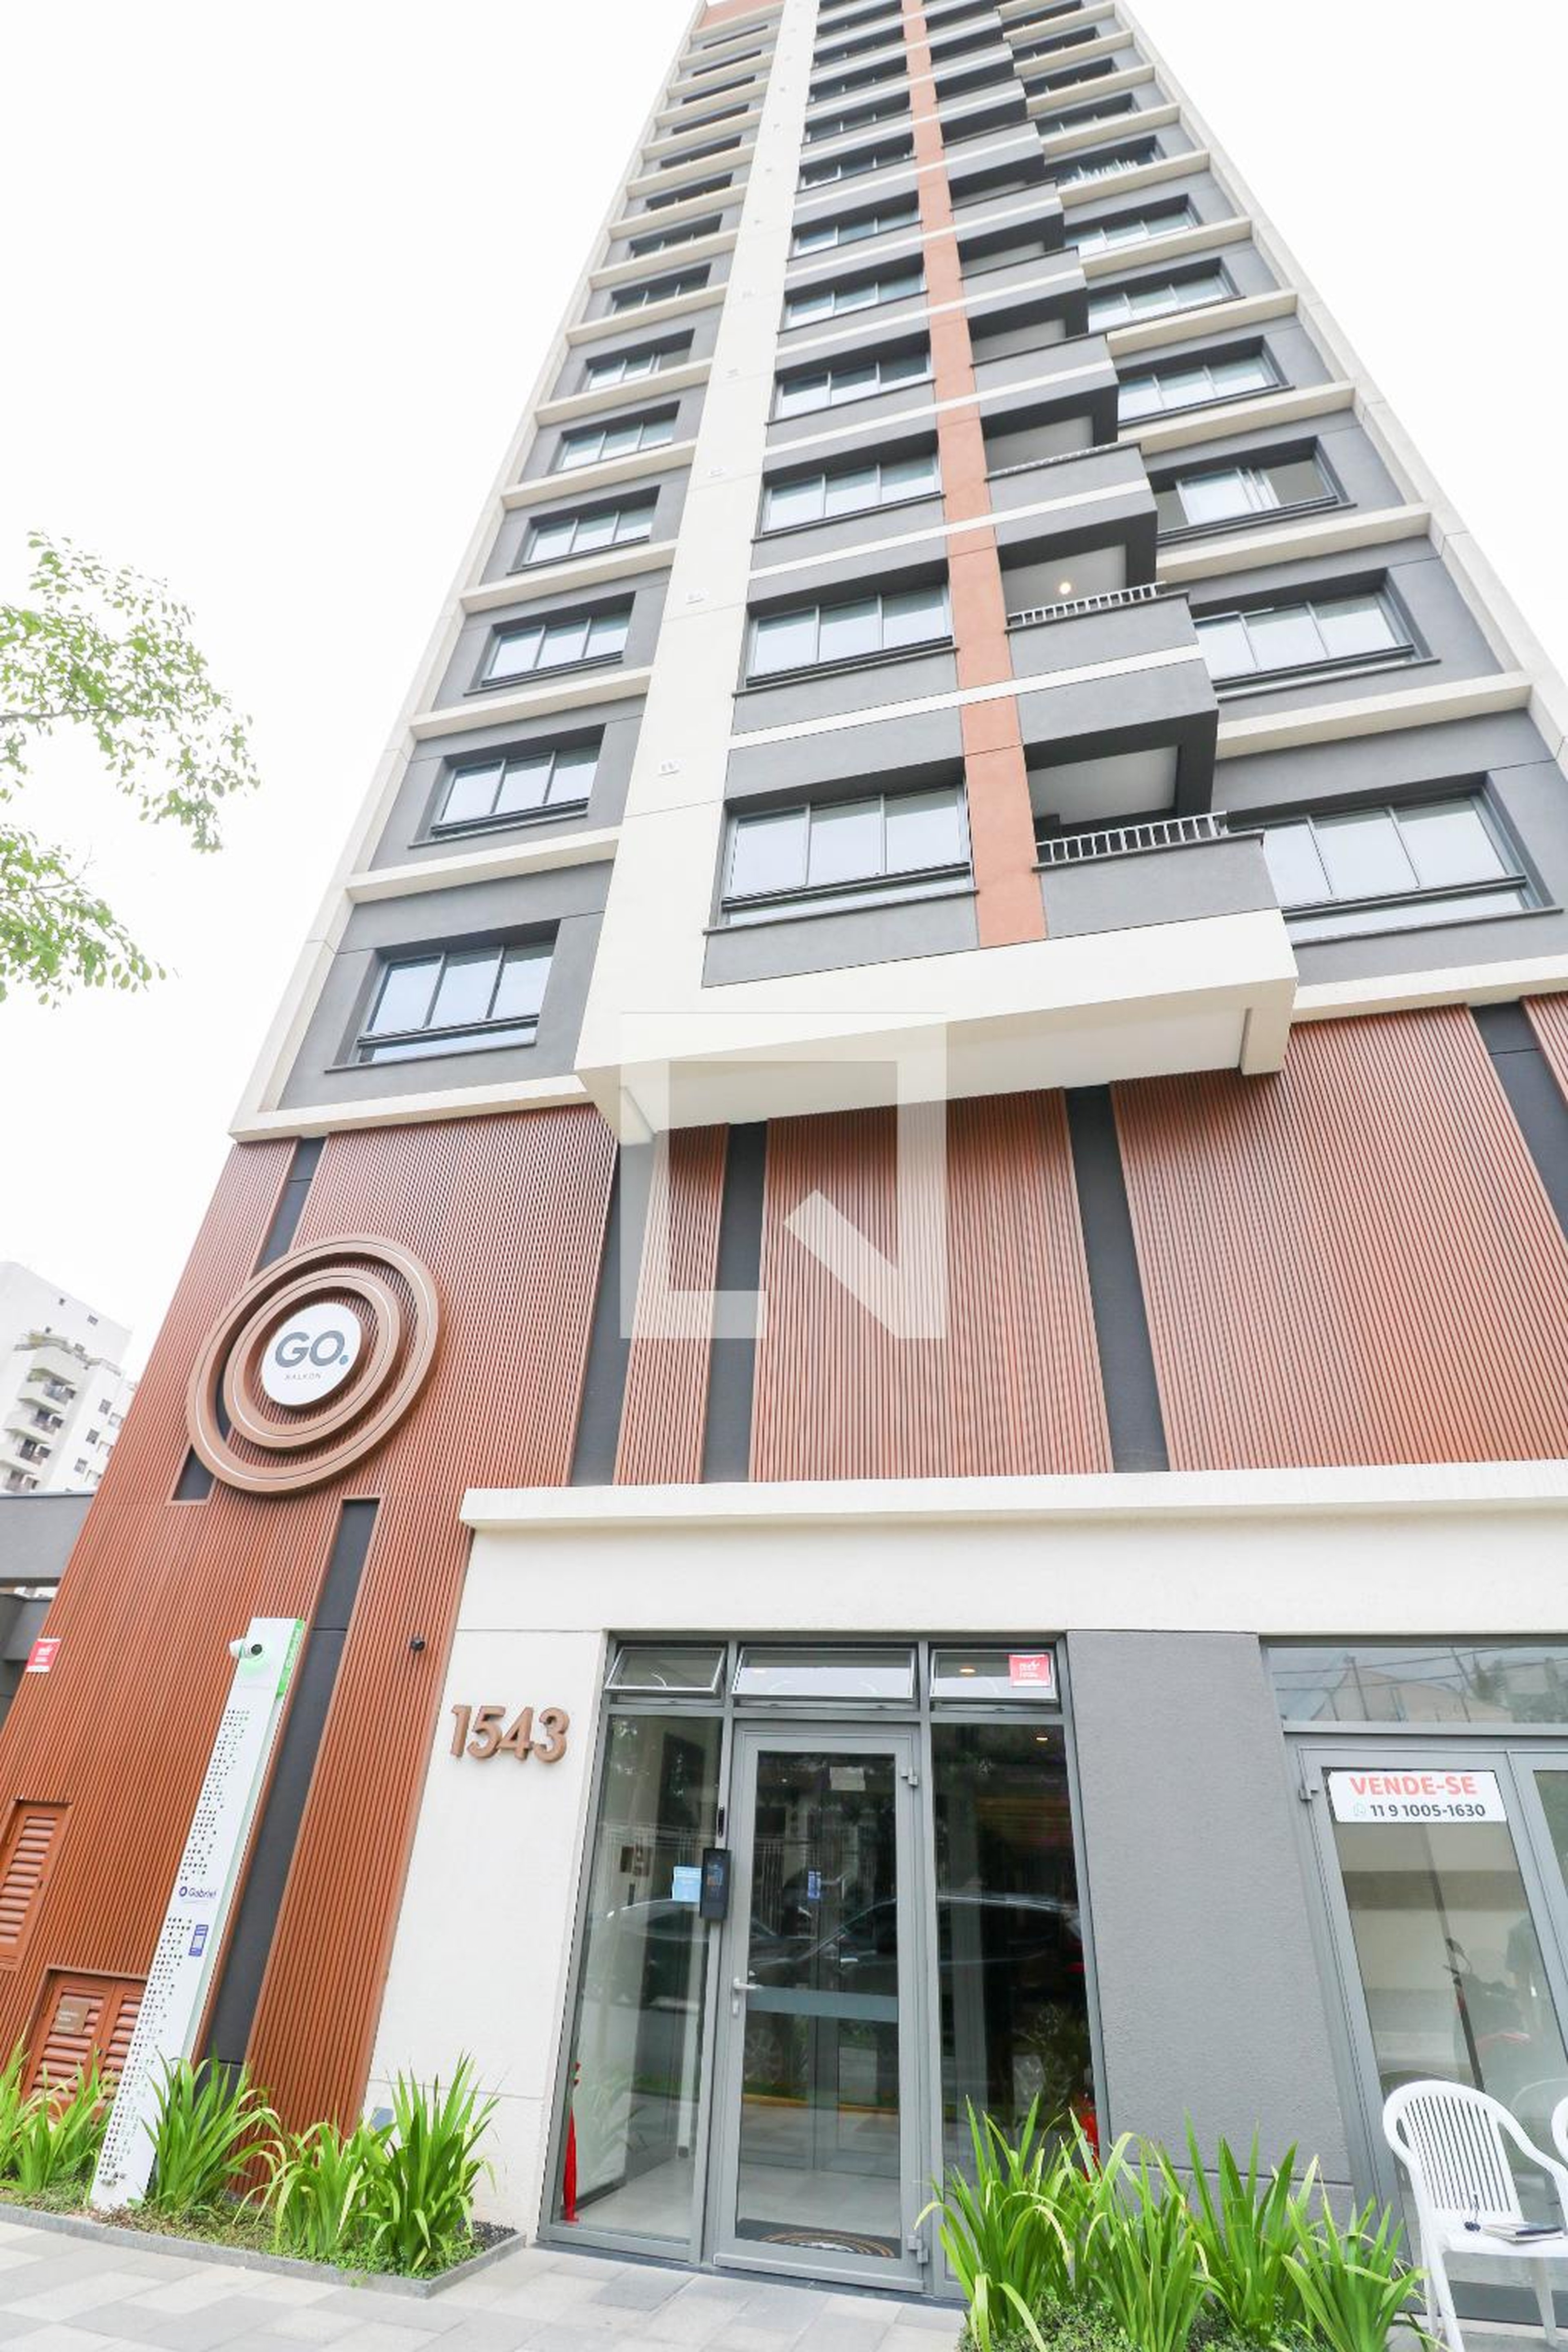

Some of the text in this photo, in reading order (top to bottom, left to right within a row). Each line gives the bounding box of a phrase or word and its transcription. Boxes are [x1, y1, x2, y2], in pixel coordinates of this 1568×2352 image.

[275, 1330, 350, 1368] GO.
[450, 1704, 570, 1762] 1543
[1349, 1776, 1477, 1795] VENDE-SE
[1370, 1804, 1486, 1817] 11 9 1005-1630
